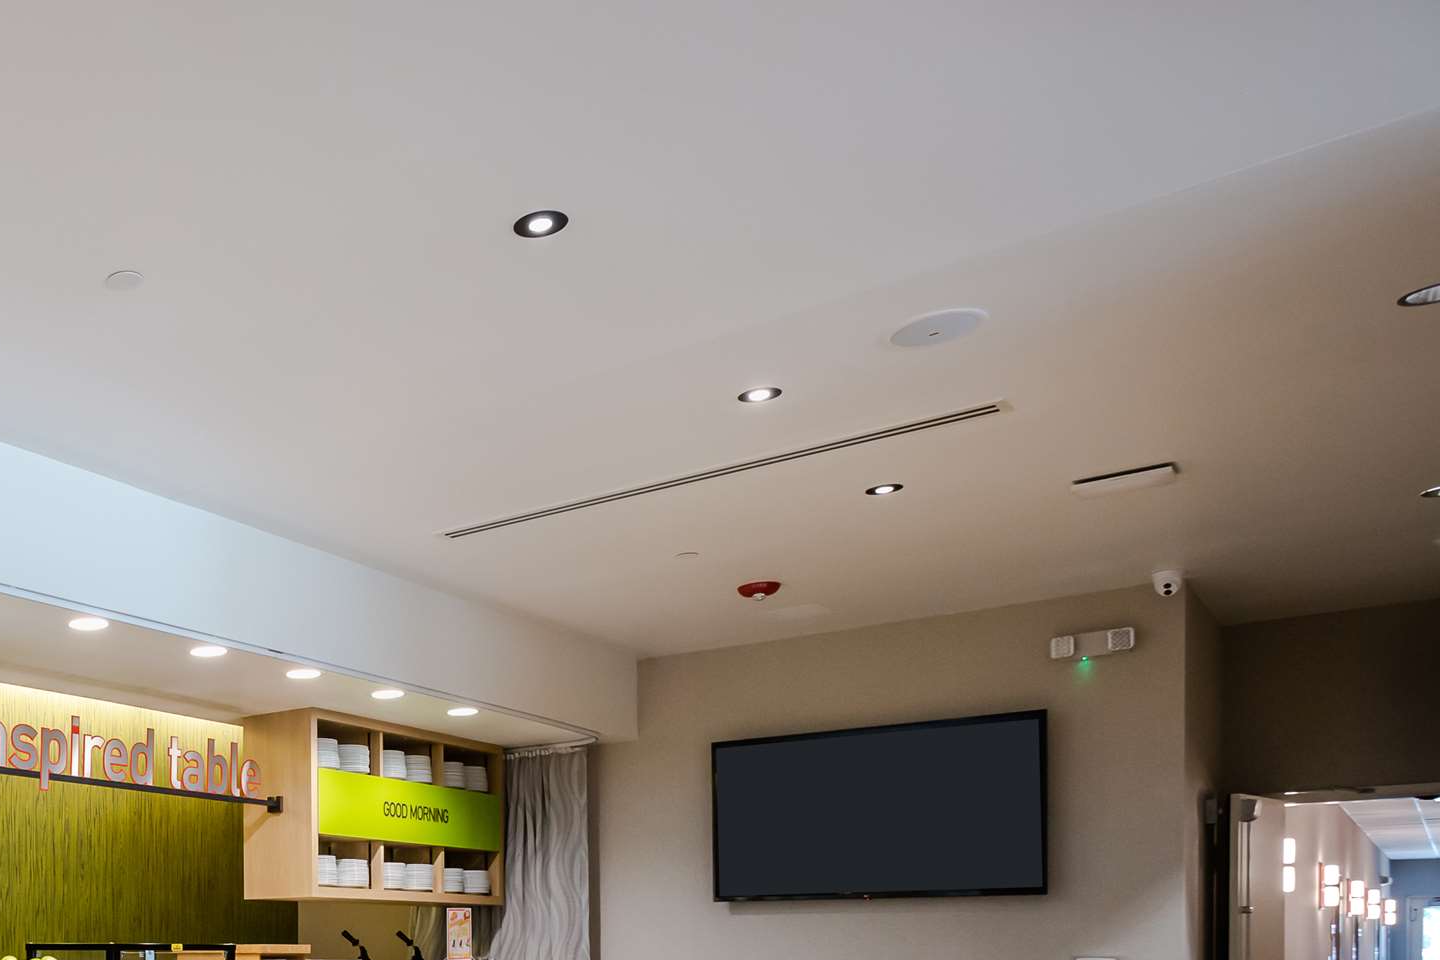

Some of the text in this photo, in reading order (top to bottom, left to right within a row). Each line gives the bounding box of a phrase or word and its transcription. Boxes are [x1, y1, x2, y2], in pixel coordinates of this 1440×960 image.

[167, 735, 261, 799] table
[383, 801, 449, 824] GOOD MORNING
